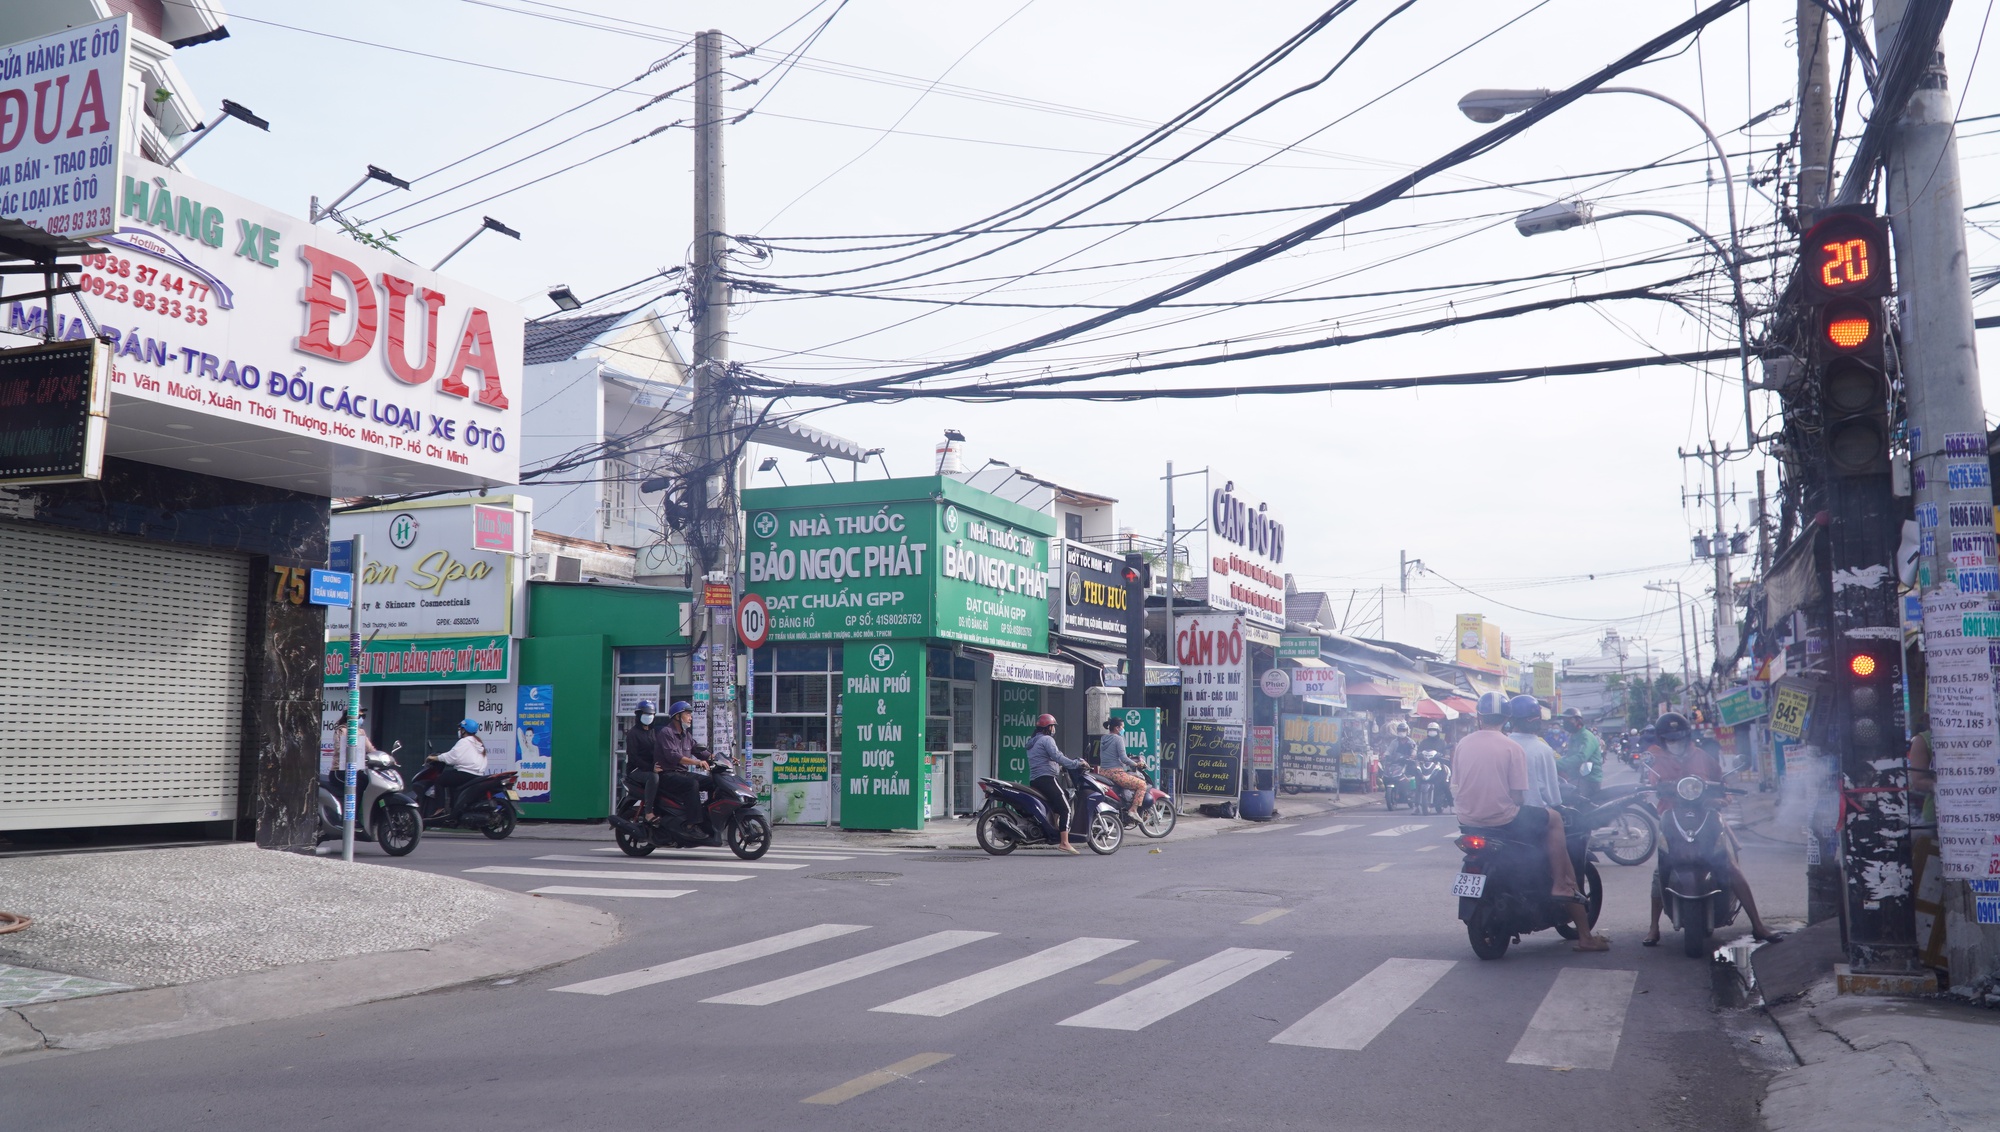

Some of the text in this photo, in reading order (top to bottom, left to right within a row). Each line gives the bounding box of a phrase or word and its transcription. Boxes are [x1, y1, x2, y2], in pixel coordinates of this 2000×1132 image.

[26, 23, 120, 75] HÀNG XE ÔTÔ
[0, 68, 111, 154] ĐUA
[15, 157, 41, 183] BÁN
[54, 149, 86, 176] TRAO
[90, 136, 112, 168] ĐỔI
[22, 173, 98, 213] LOẠI XE ÔTÔ
[47, 206, 111, 234] 0923 93 33 33
[121, 176, 281, 269] HÀNG XE
[129, 234, 167, 256] Hotline
[1823, 238, 1868, 286] 20
[81, 252, 210, 302] 0938 37 44 77
[81, 273, 208, 326] 0923 93 33 33
[294, 244, 509, 411] ĐUA
[133, 372, 160, 395] Văn
[449, 447, 469, 466] Minh
[267, 364, 313, 405] ĐỔI
[319, 386, 369, 420] CÁC
[373, 403, 422, 438] LOẠI
[427, 415, 457, 441] XE
[464, 420, 506, 463] ÔTÔ
[790, 505, 906, 537] NHÀ THUỐC
[968, 520, 1035, 558] NHÀ THUỐC TÂY
[750, 536, 928, 583] BẢO NGỌC PHÁT
[943, 540, 1049, 601] BẢO NGỌC PHÁT
[405, 550, 493, 597] Spa
[274, 567, 305, 605] 75
[1084, 580, 1105, 606] THU
[385, 600, 416, 609] Skincare
[765, 587, 905, 613] ĐẠT CHUẨN GPP
[966, 597, 1026, 621] ĐẠT CHUẨN GPP
[1924, 600, 1980, 614] CHO VAY GÓP
[779, 613, 801, 628] BĂNG
[845, 616, 858, 627] GP
[1177, 618, 1242, 666] CẦM ĐỒ
[1929, 645, 1987, 658] CHO VAY GÓP
[326, 649, 343, 676] SÓC
[373, 653, 387, 678] TRỊ
[388, 653, 401, 674] DA
[430, 648, 455, 679] DƯỢC
[485, 683, 497, 693] Da
[847, 670, 911, 694] PHÂN PHỐI
[1217, 672, 1225, 684] XE
[1305, 682, 1325, 692] BOY
[877, 698, 886, 715] &
[1003, 686, 1035, 703] DƯỢC
[1003, 709, 1036, 727] PHẨM
[1776, 702, 1799, 724] 845
[857, 718, 902, 742] TƯ VẤN
[1289, 743, 1332, 756] BOY
[1935, 738, 1993, 749] CHO VAY GÓP
[862, 749, 895, 770] DƯỢC
[1009, 758, 1025, 774] CỤ
[516, 781, 549, 791] 49.000đ
[850, 770, 910, 795] MỸ PHẨM
[1940, 785, 1998, 797] CHO VAY GÓP
[1942, 836, 1978, 846] CHO VAY
[1453, 885, 1481, 896] 662.92
